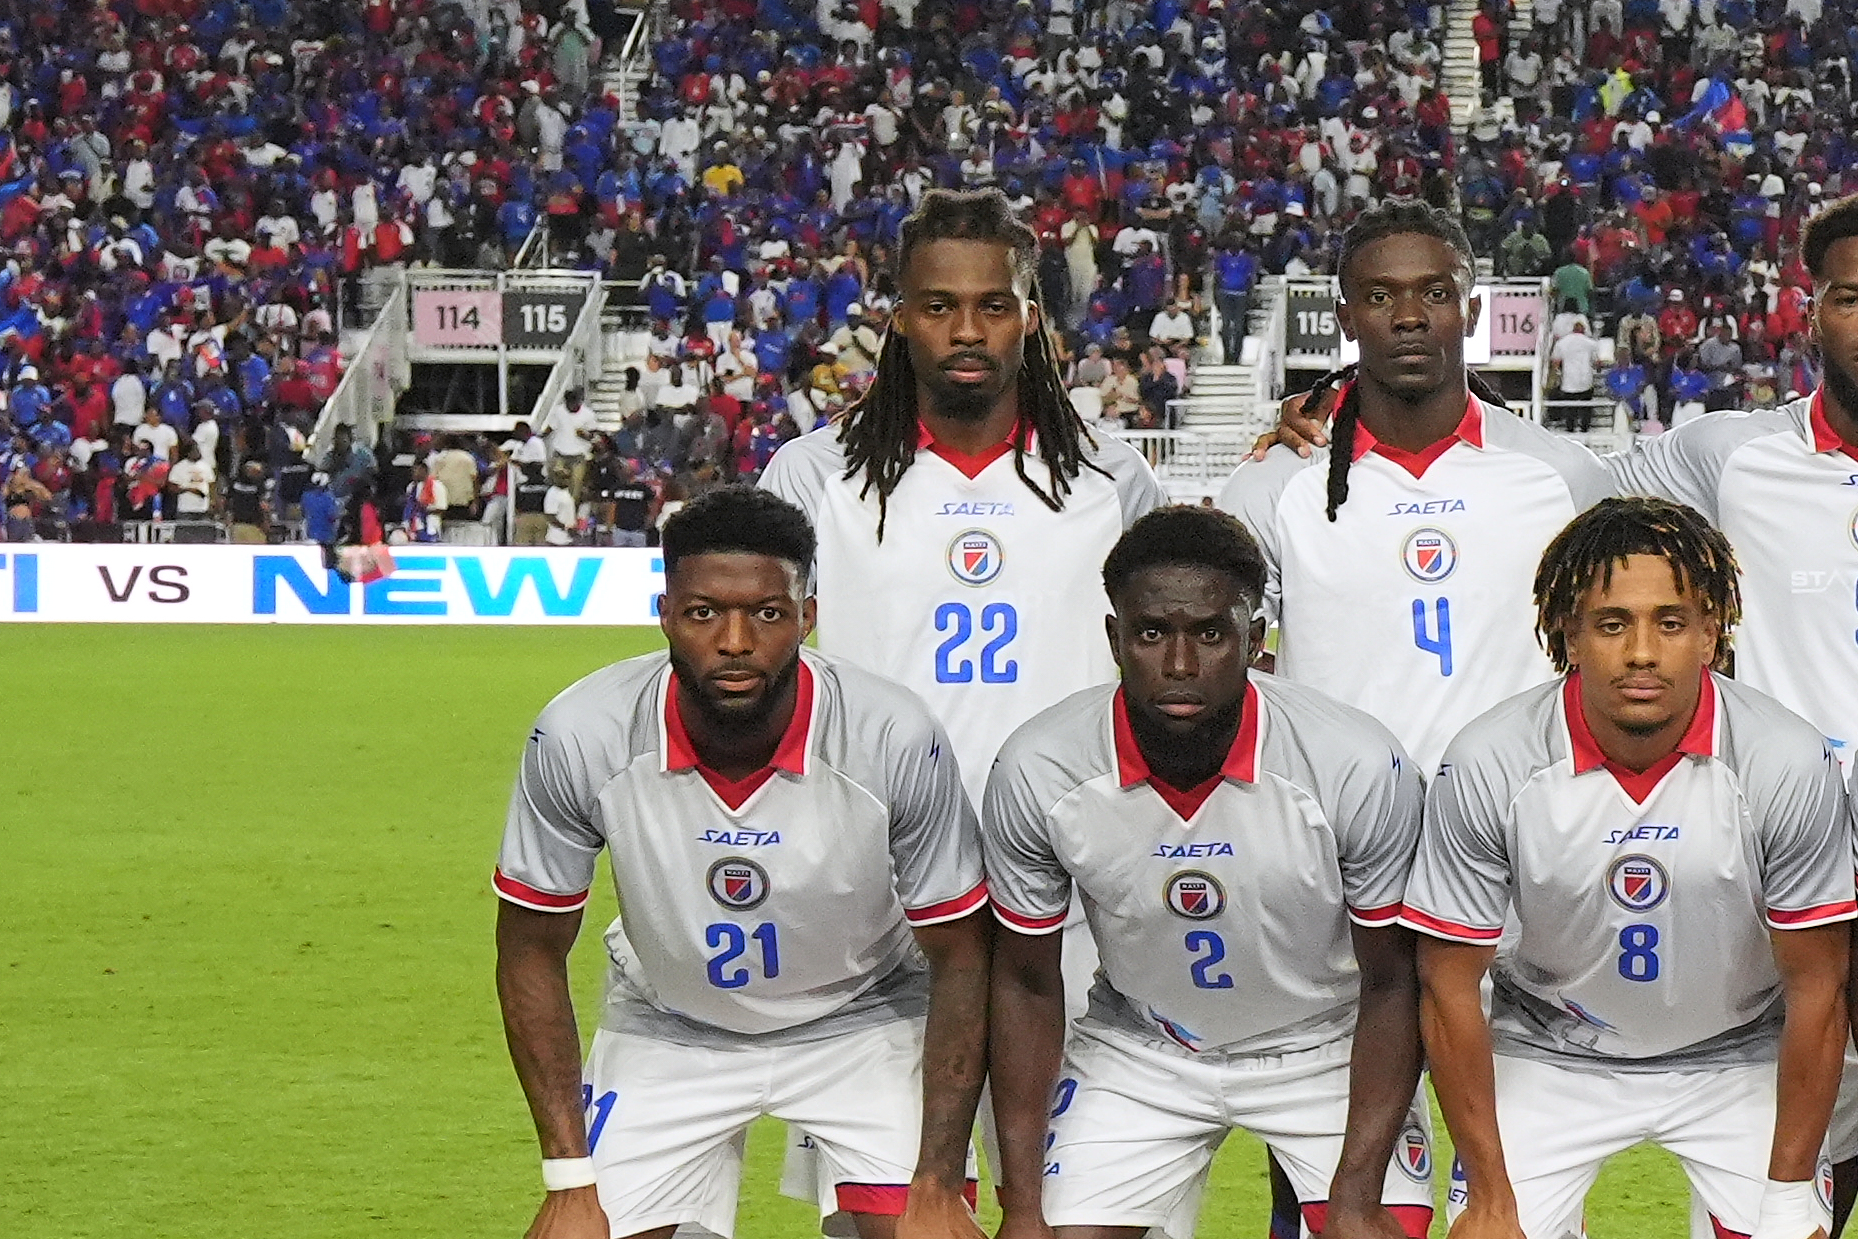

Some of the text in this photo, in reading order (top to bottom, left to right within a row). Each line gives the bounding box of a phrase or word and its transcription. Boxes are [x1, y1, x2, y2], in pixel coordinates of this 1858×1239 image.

[437, 305, 480, 331] 114
[520, 304, 568, 333] 115
[1297, 310, 1335, 336] 115
[1499, 312, 1535, 336] 116
[935, 502, 1015, 516] SAETA
[1387, 499, 1466, 516] SAETA
[97, 565, 190, 603] VS
[253, 555, 604, 616] NEW
[935, 602, 1018, 684] 22
[1412, 596, 1453, 677] 4
[697, 829, 781, 846] SAETA
[1602, 826, 1679, 844] SAETA
[1151, 842, 1234, 858] SAETA
[705, 922, 779, 989] 21
[1184, 930, 1234, 989] 2
[1618, 923, 1660, 982] 8
